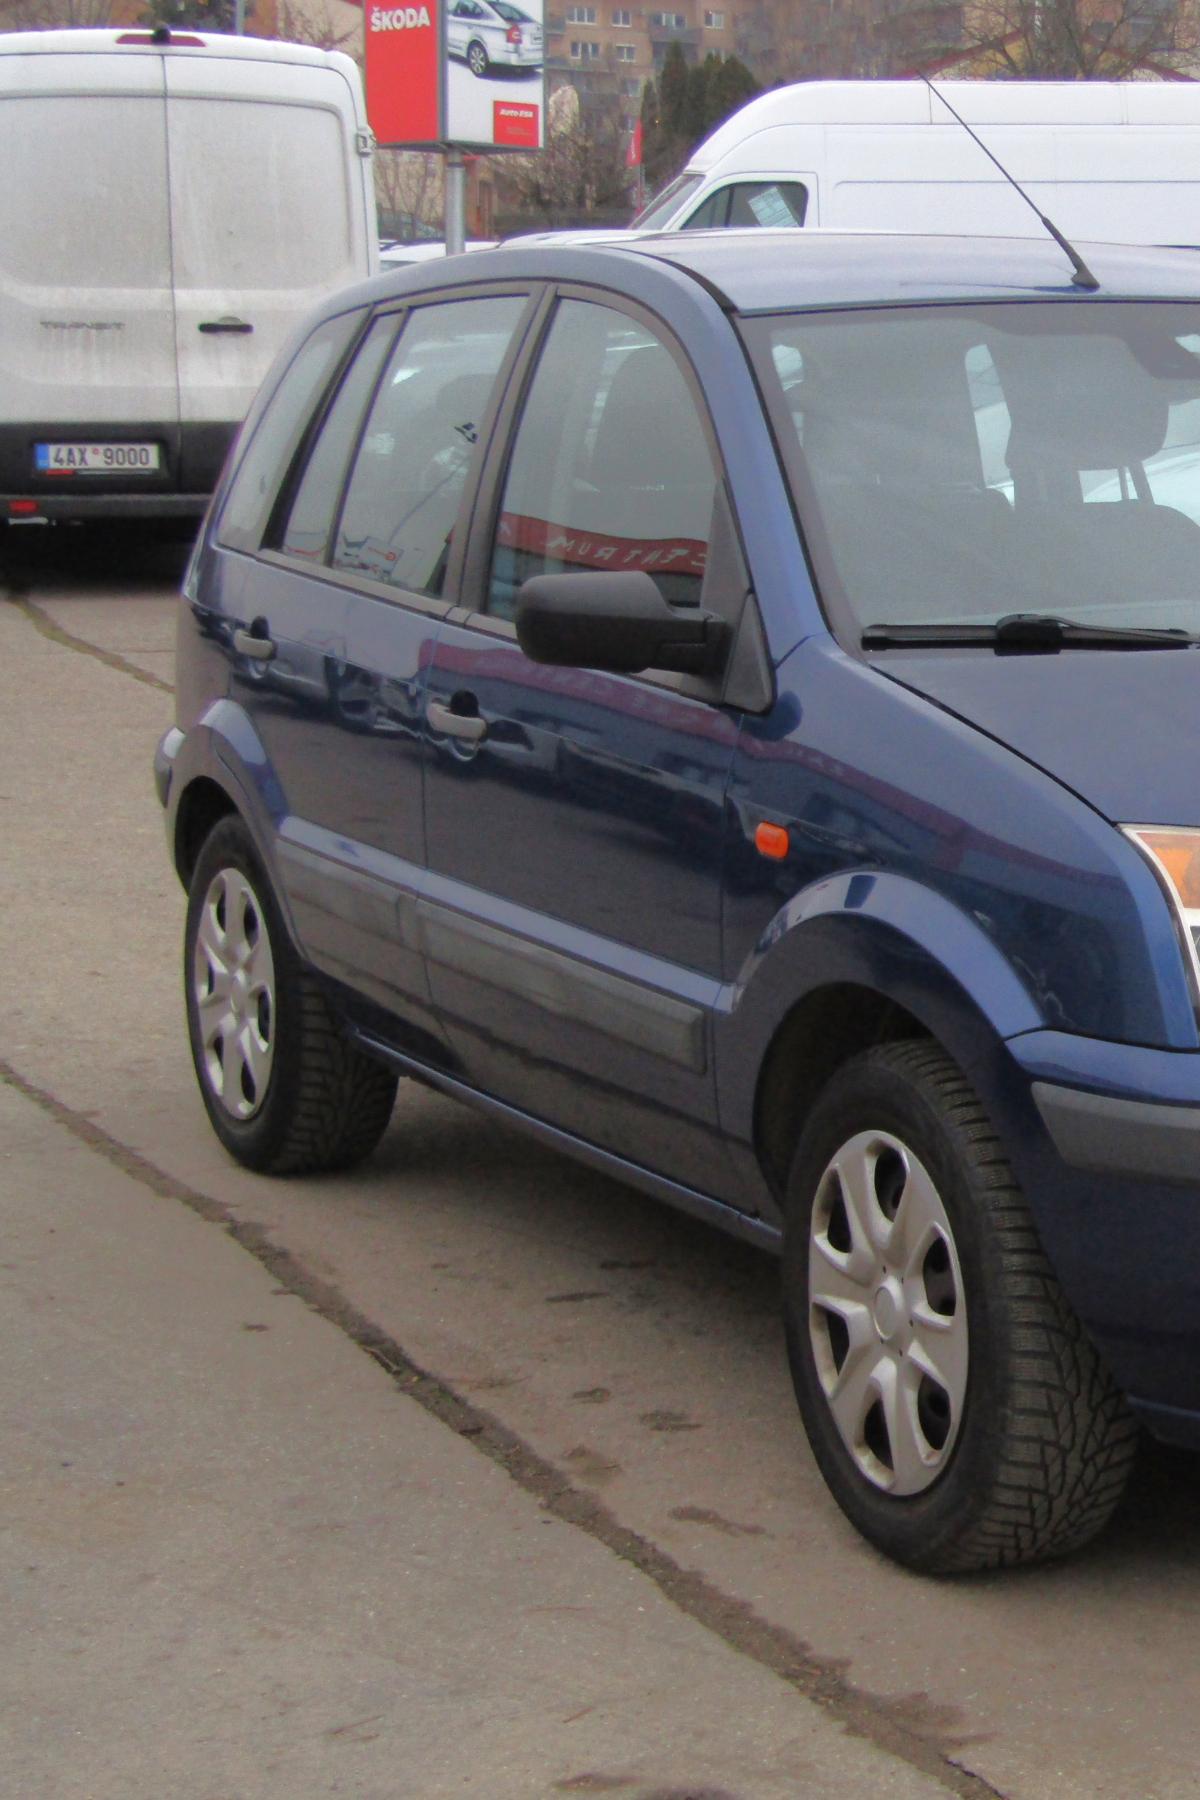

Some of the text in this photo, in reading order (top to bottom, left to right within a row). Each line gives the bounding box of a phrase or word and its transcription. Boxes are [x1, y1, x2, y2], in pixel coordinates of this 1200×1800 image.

[370, 6, 431, 32] ŠKODA
[53, 448, 150, 467] 4AX 9000
